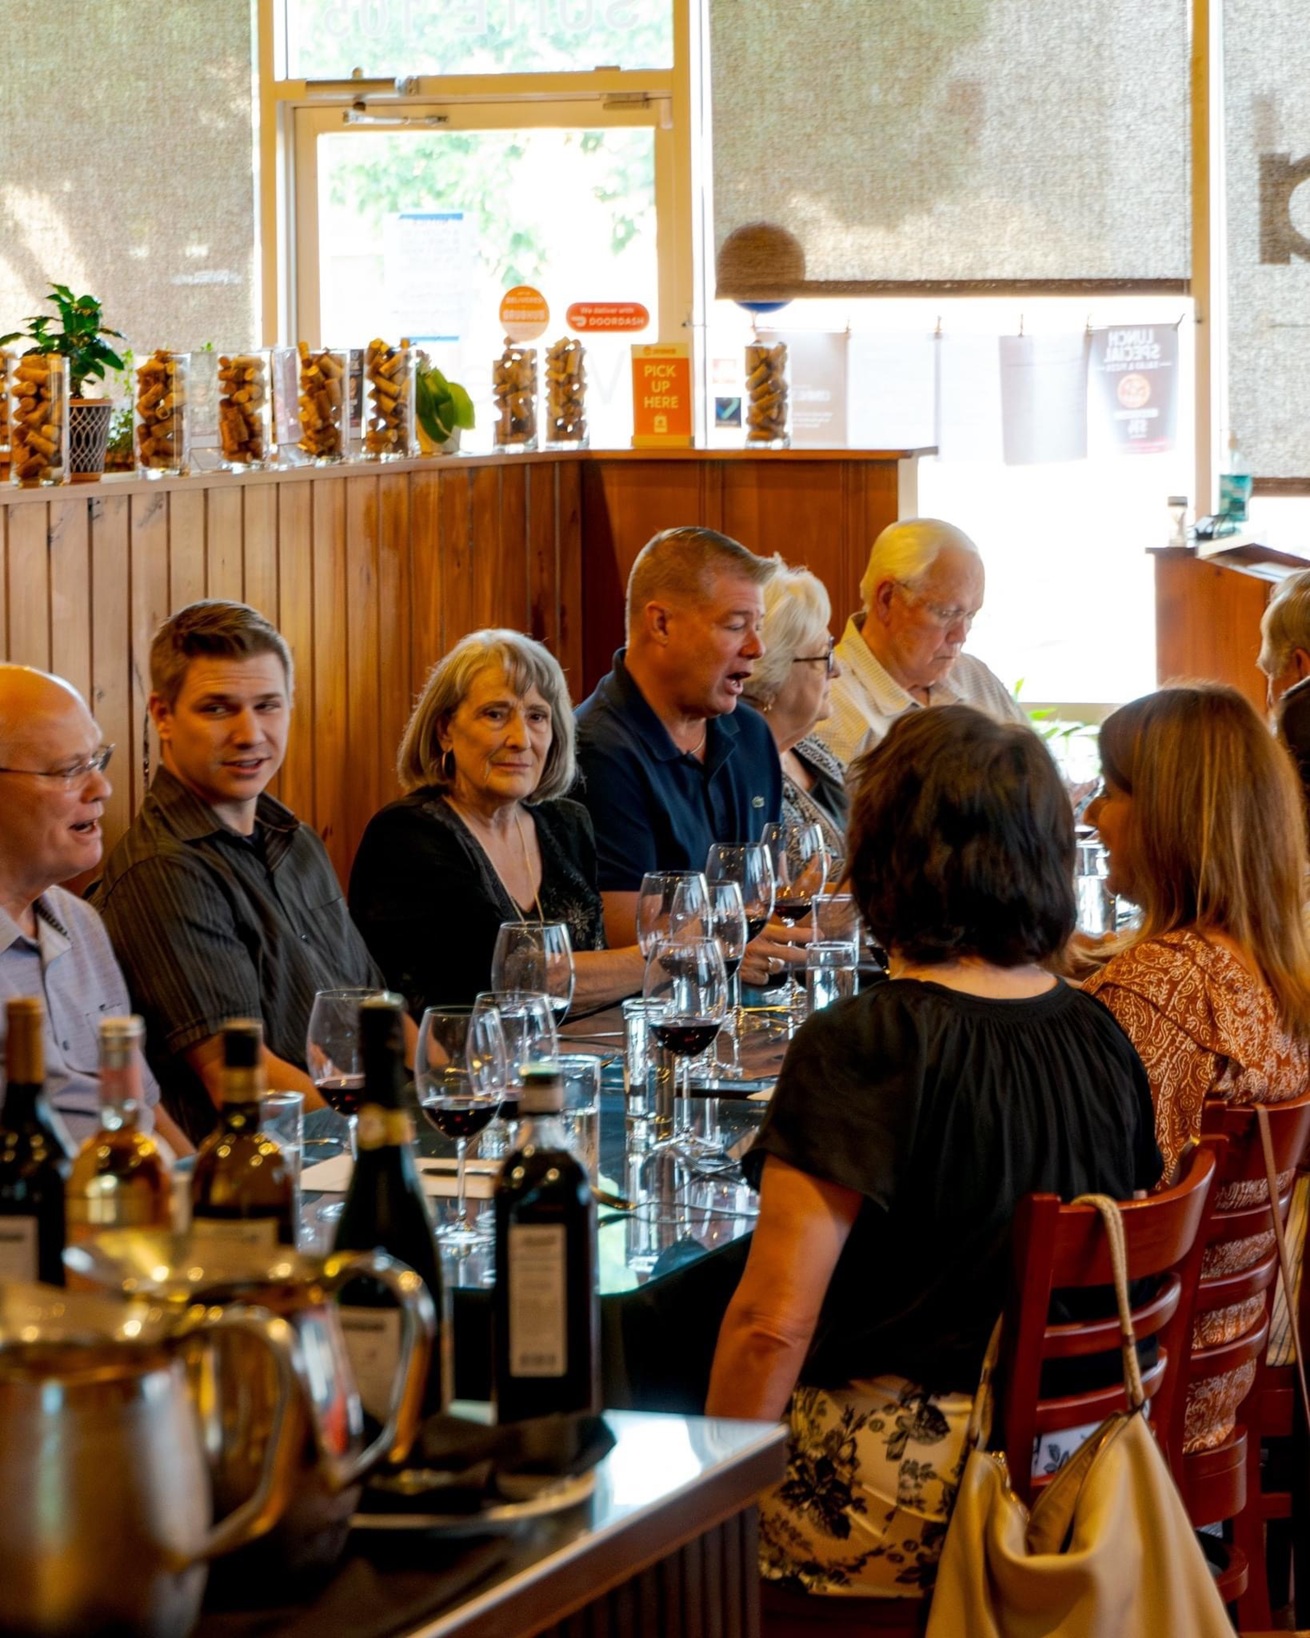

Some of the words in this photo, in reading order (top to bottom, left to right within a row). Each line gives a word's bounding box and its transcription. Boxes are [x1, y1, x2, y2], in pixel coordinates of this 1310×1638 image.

[580, 306, 592, 315] We
[593, 306, 617, 315] deliver
[618, 306, 635, 315] with
[589, 316, 645, 326] DOORDASH
[644, 364, 676, 378] PICK
[651, 380, 671, 393] UP
[643, 396, 679, 409] HERE
